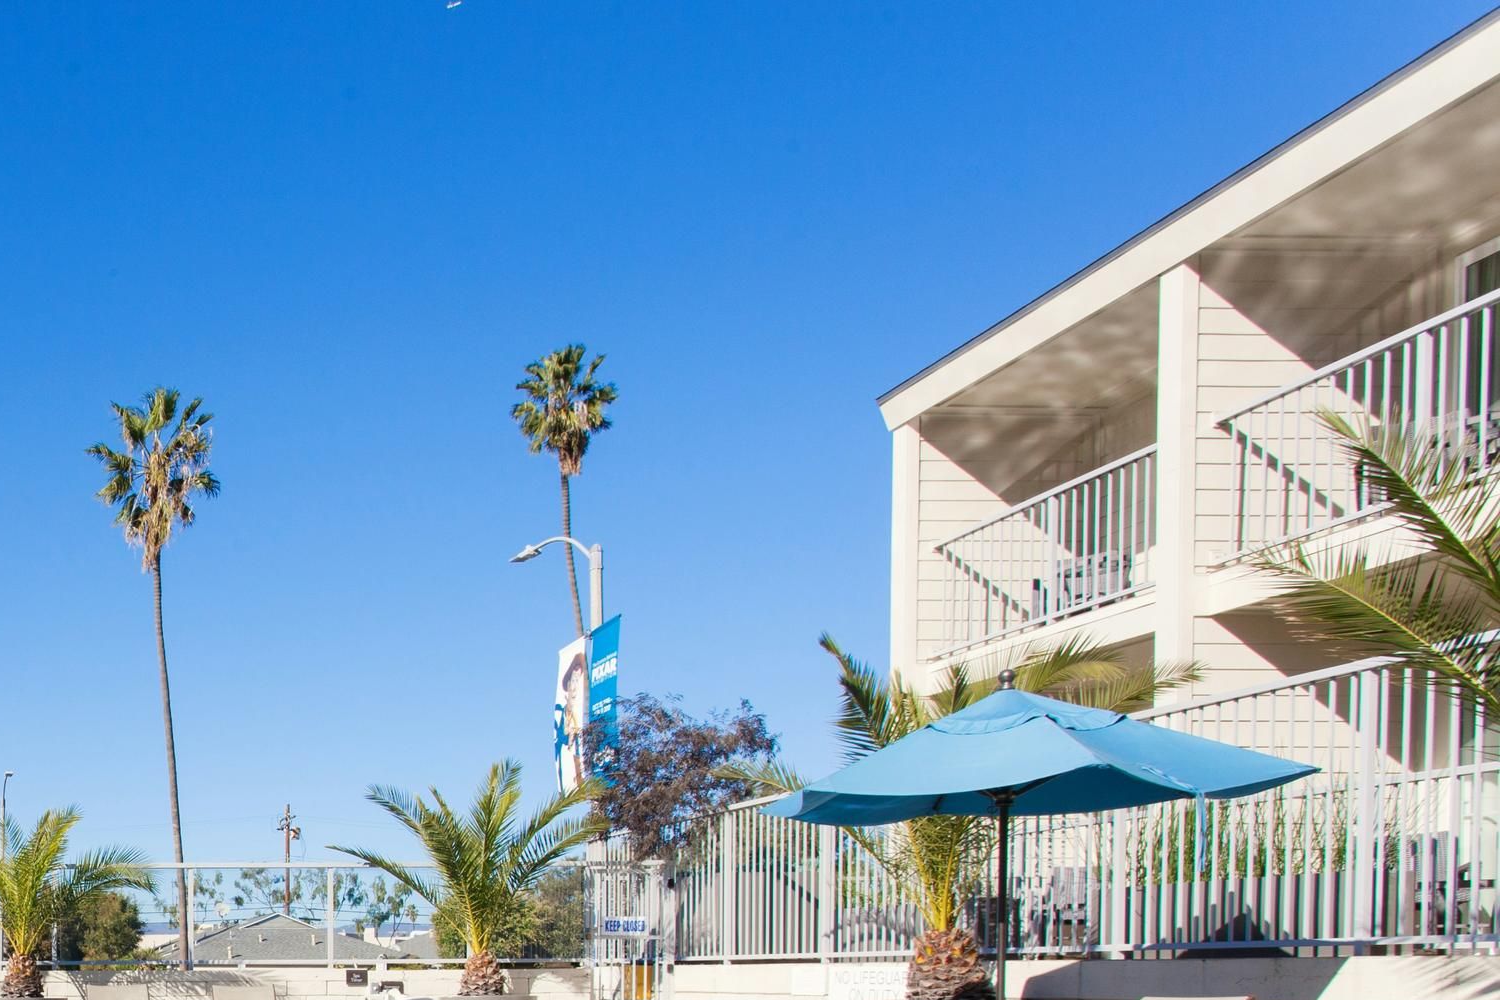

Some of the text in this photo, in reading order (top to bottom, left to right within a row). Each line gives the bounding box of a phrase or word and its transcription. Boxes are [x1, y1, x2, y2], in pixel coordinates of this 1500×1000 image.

[605, 920, 645, 932] KEEP CLOSED
[835, 971, 908, 985] NO LIFEGUAR
